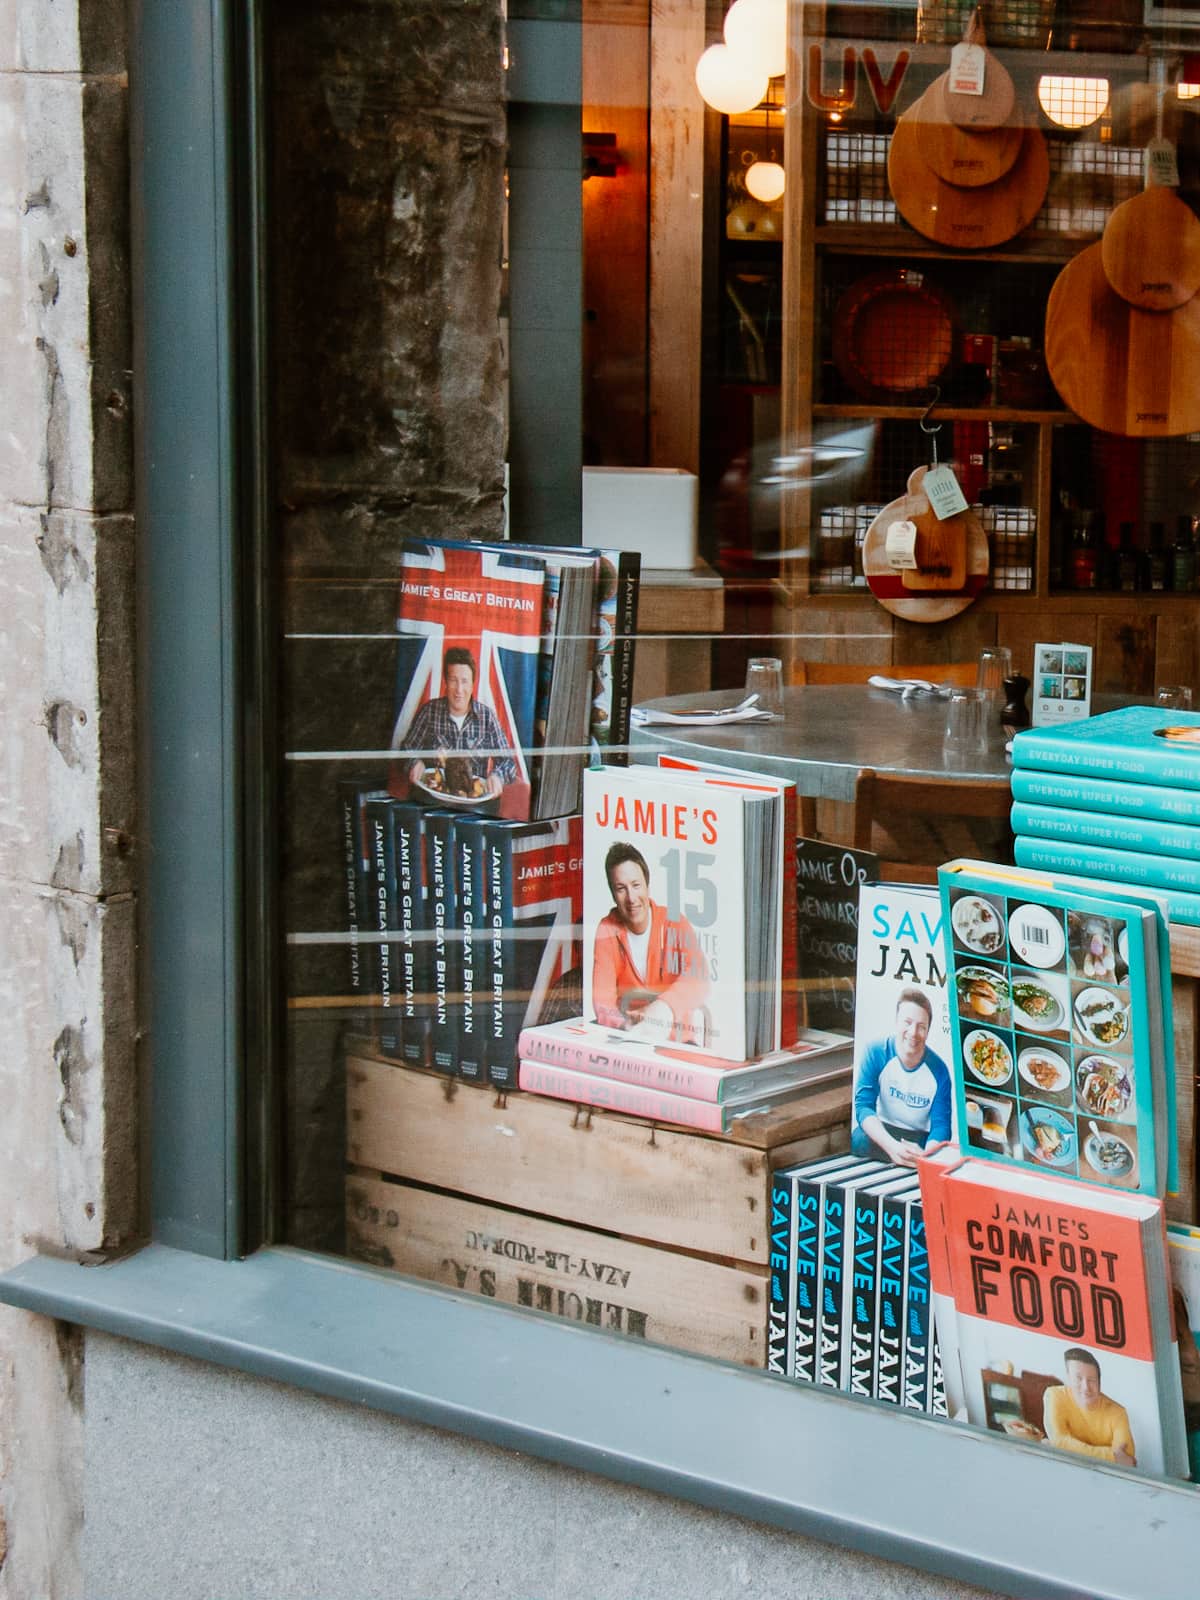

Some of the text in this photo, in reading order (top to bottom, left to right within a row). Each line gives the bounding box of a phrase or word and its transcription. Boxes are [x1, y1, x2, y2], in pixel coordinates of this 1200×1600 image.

[400, 581, 535, 611] JAMIE'S GREAT BRITAIN
[616, 696, 628, 760] BRITAN
[1029, 750, 1080, 765] EVERYDAY
[1082, 757, 1114, 769] SUPER
[1162, 768, 1194, 780] JAMIE
[595, 793, 719, 845] JAMIE'S
[1028, 784, 1079, 799] EVERYDAY
[1081, 791, 1112, 803] SUPER
[1160, 801, 1192, 814] JAMIE
[375, 821, 386, 885] JAMIE'S
[517, 862, 566, 880] JAMIE'S
[660, 847, 719, 928] 15
[1167, 906, 1197, 918] AMIE
[400, 828, 415, 1017] JAMIE'S GREAT BRITAIN
[433, 835, 447, 1025] JAMIE'S GREAT BRITAIN
[463, 843, 473, 1034] JAMIE'S GREAT BRITAIN
[492, 846, 504, 1038] JAMIE'S GREAT BRITAIN
[380, 944, 390, 1008] BRITAIN
[771, 1187, 790, 1271] SAVE
[796, 1193, 816, 1278] SAVE
[822, 1200, 842, 1284] SAVE
[853, 1207, 876, 1291] SAVE
[881, 1211, 903, 1297] SAVE
[966, 1219, 1119, 1284] COMFORT
[990, 1203, 1091, 1242] JAMIE'S
[772, 1275, 784, 1302] with
[908, 1219, 928, 1304] SAVE
[799, 1282, 812, 1309] with
[824, 1288, 837, 1314] with
[856, 1296, 870, 1323] with
[884, 1301, 897, 1328] with
[910, 1308, 923, 1336] with
[970, 1254, 1127, 1350] FOOD
